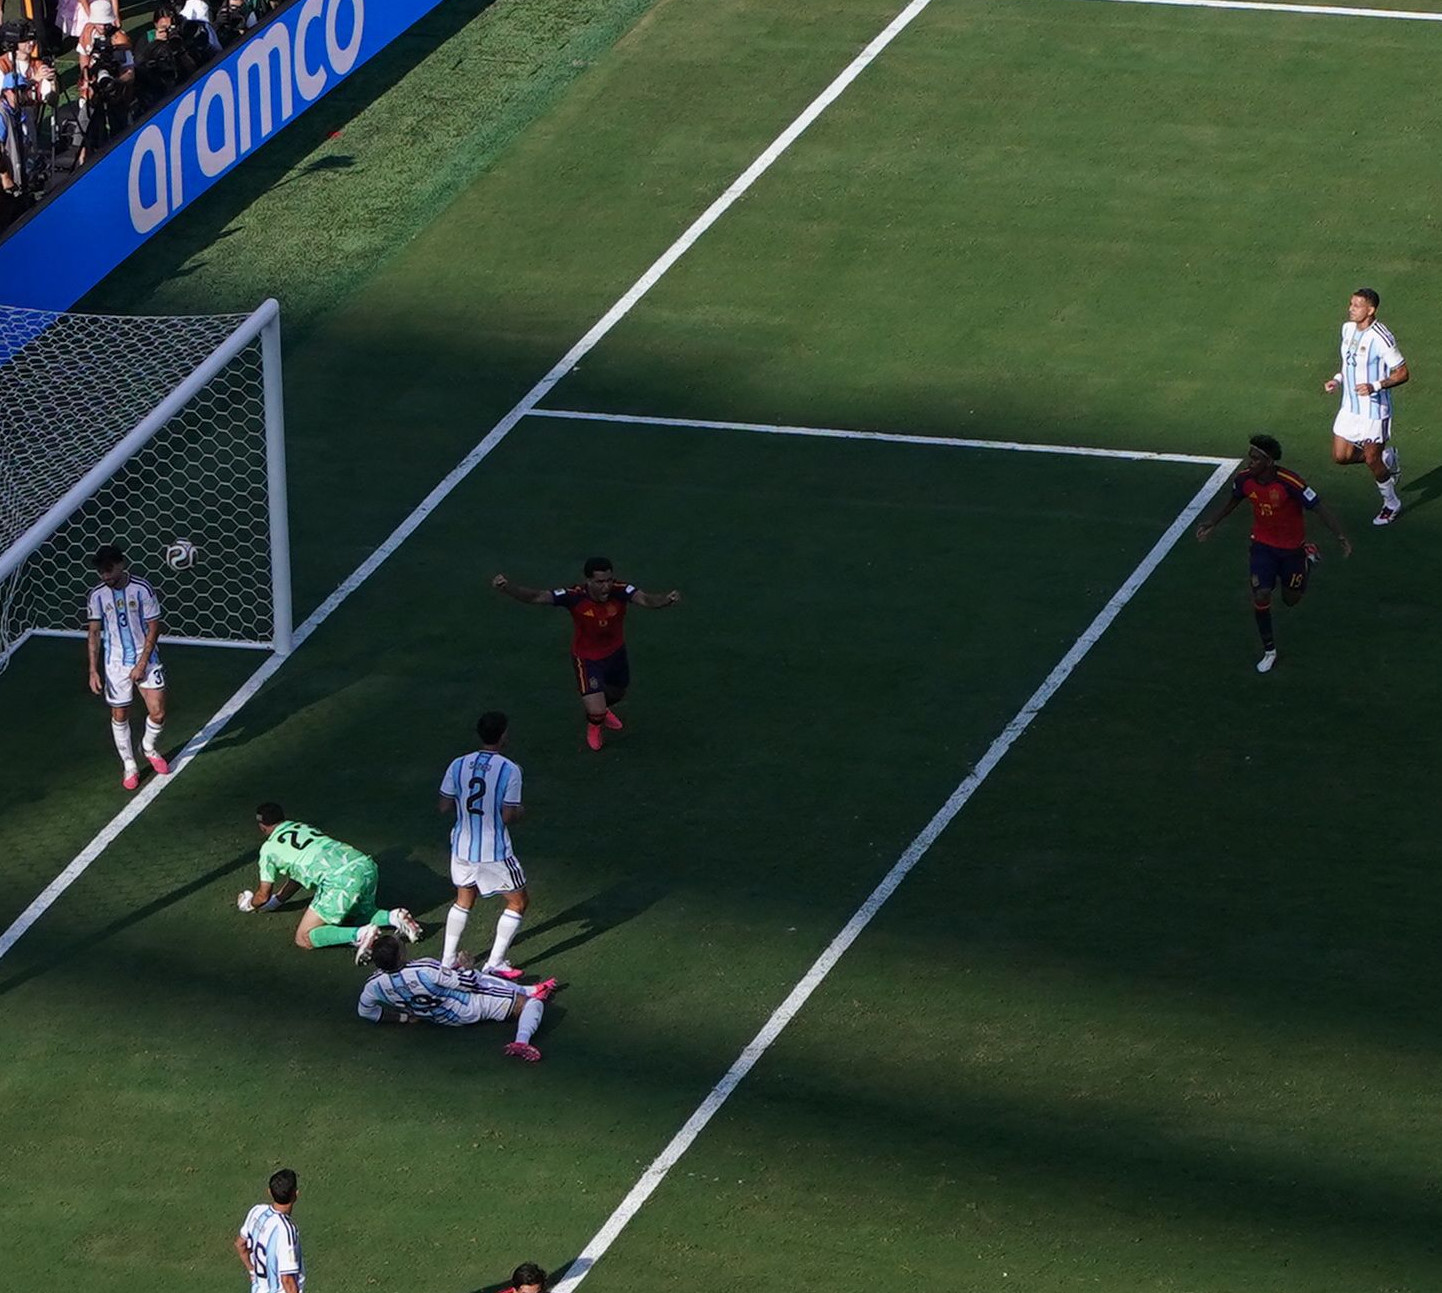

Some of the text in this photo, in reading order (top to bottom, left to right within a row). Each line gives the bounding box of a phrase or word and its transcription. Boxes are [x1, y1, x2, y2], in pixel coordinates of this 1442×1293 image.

[118, 612, 128, 628] 3
[153, 669, 163, 685] 3
[466, 776, 487, 816] 2
